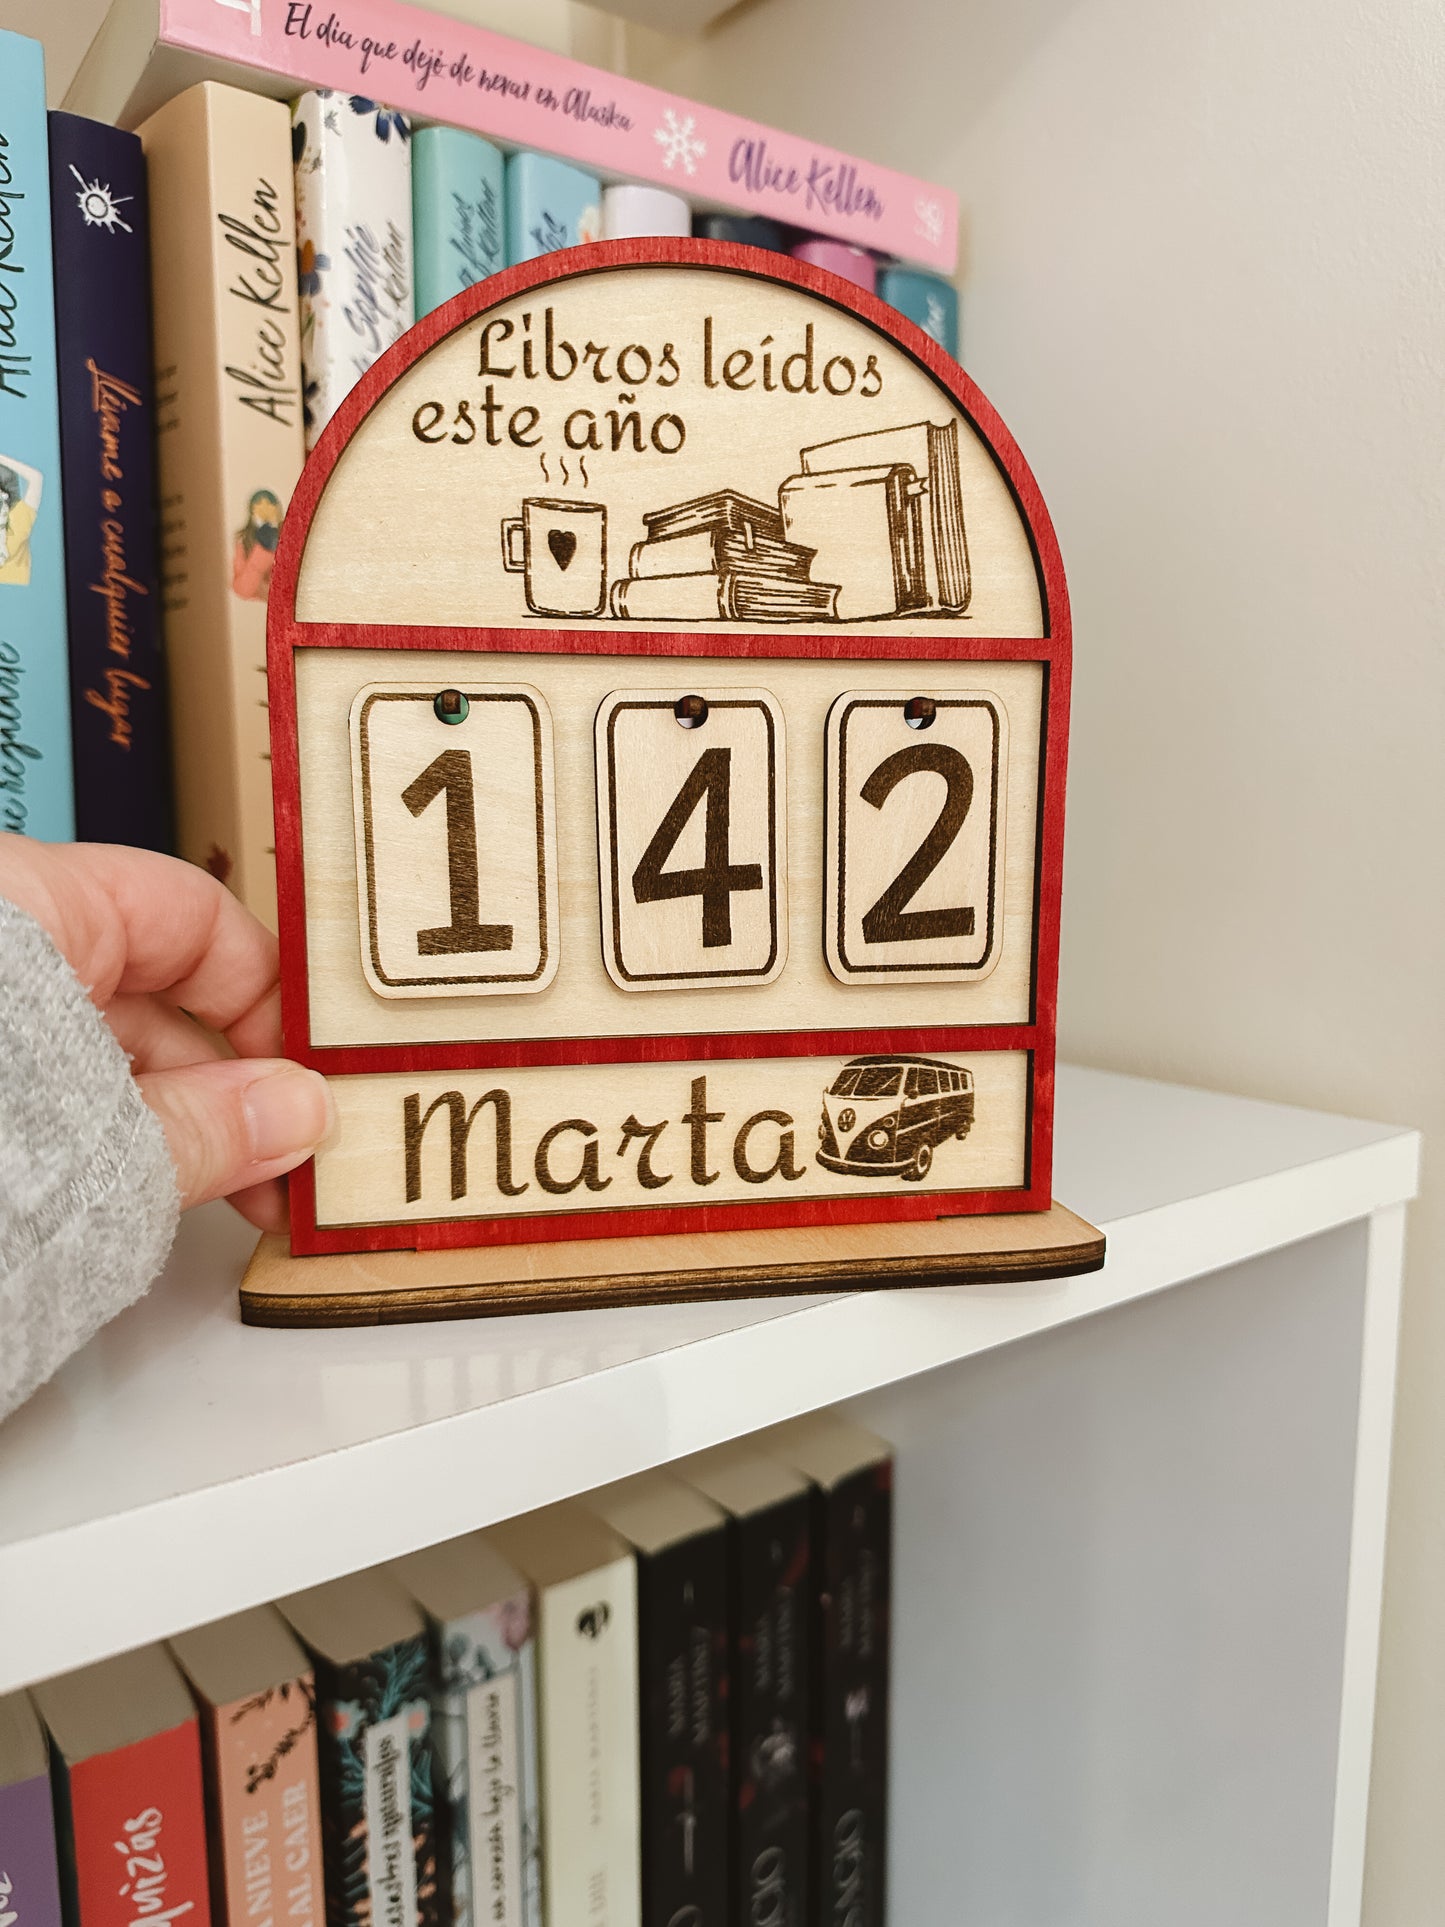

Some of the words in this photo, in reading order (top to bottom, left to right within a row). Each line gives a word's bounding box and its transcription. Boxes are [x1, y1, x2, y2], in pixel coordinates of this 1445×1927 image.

[284, 2, 312, 39] El
[362, 37, 399, 74] que
[403, 40, 448, 91] dejó
[450, 53, 475, 83] de
[536, 85, 560, 110] en
[563, 88, 635, 132] Alaska
[728, 137, 802, 194] Alice
[805, 158, 885, 221] Kellen
[218, 178, 291, 313] Kellen
[225, 324, 295, 428] Alice
[478, 307, 681, 387] Libros
[703, 316, 884, 398] leídos
[412, 385, 543, 448] este
[564, 392, 686, 455] año
[101, 489, 122, 513] a
[88, 520, 149, 660] cualquier
[85, 667, 152, 751] lugar
[400, 748, 513, 956] 1
[631, 747, 763, 947] 4
[859, 743, 975, 944] 2
[403, 1075, 808, 1204] Marta
[243, 1810, 272, 1916] NIEVE
[282, 1780, 311, 1873] CAER
[288, 1872, 314, 1916] AL
